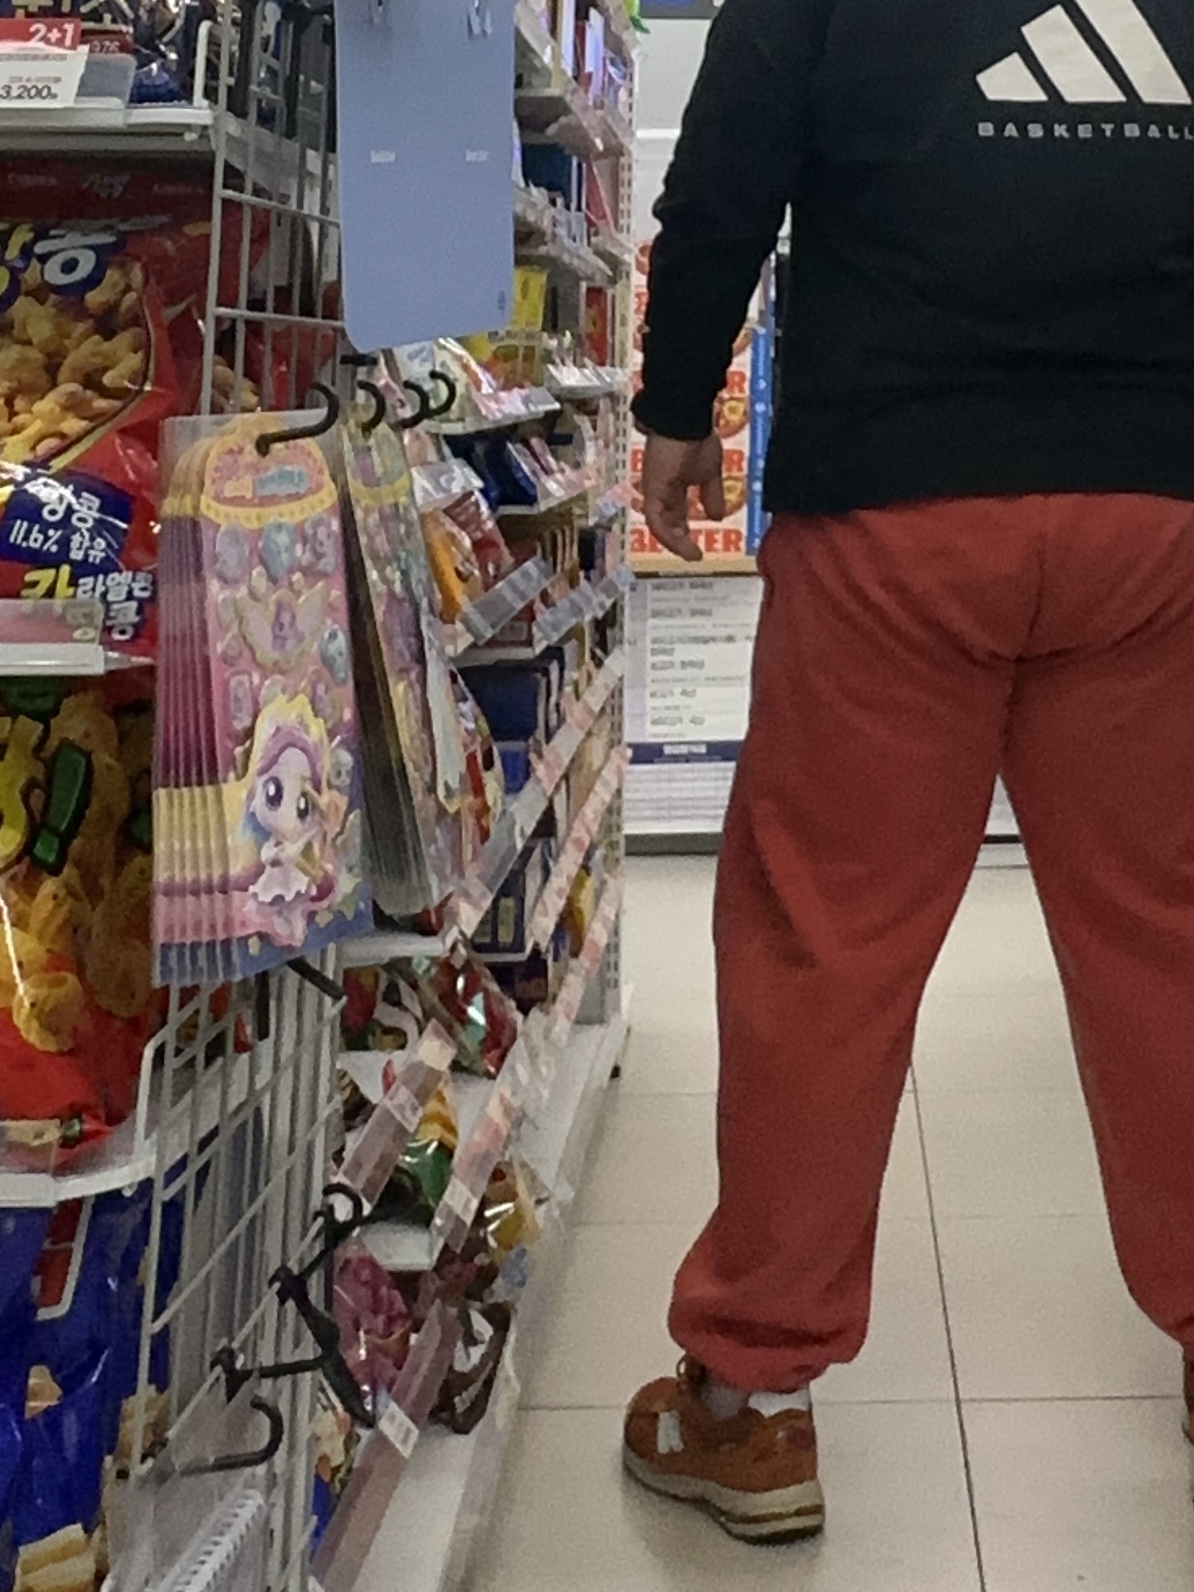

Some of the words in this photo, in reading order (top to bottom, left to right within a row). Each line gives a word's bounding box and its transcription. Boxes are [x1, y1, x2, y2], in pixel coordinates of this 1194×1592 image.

[29, 21, 76, 49] 2+1
[9, 519, 62, 553] 11.6%
[69, 530, 107, 565] 함유
[630, 528, 744, 554] BETER
